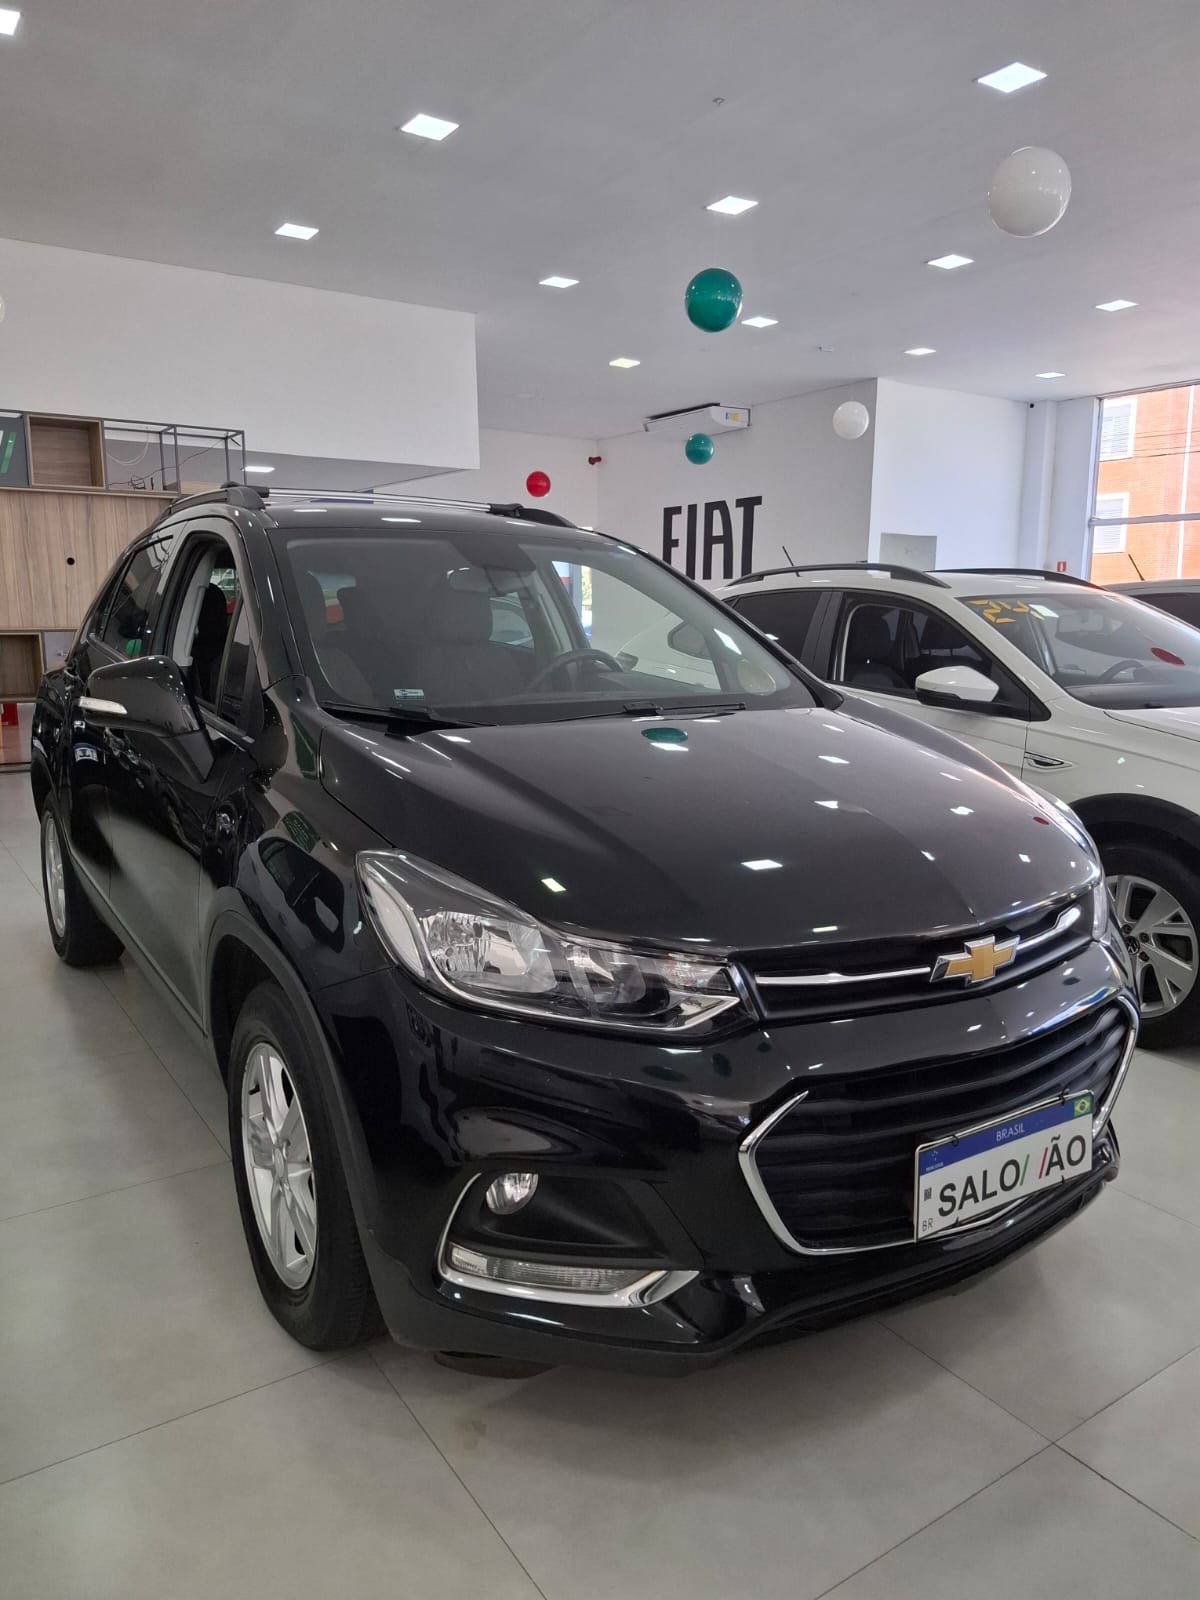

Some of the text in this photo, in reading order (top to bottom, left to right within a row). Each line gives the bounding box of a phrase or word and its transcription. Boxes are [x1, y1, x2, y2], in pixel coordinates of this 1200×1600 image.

[662, 495, 763, 581] FIAT
[995, 1122, 1025, 1142] BRASIL
[921, 1217, 934, 1232] BR
